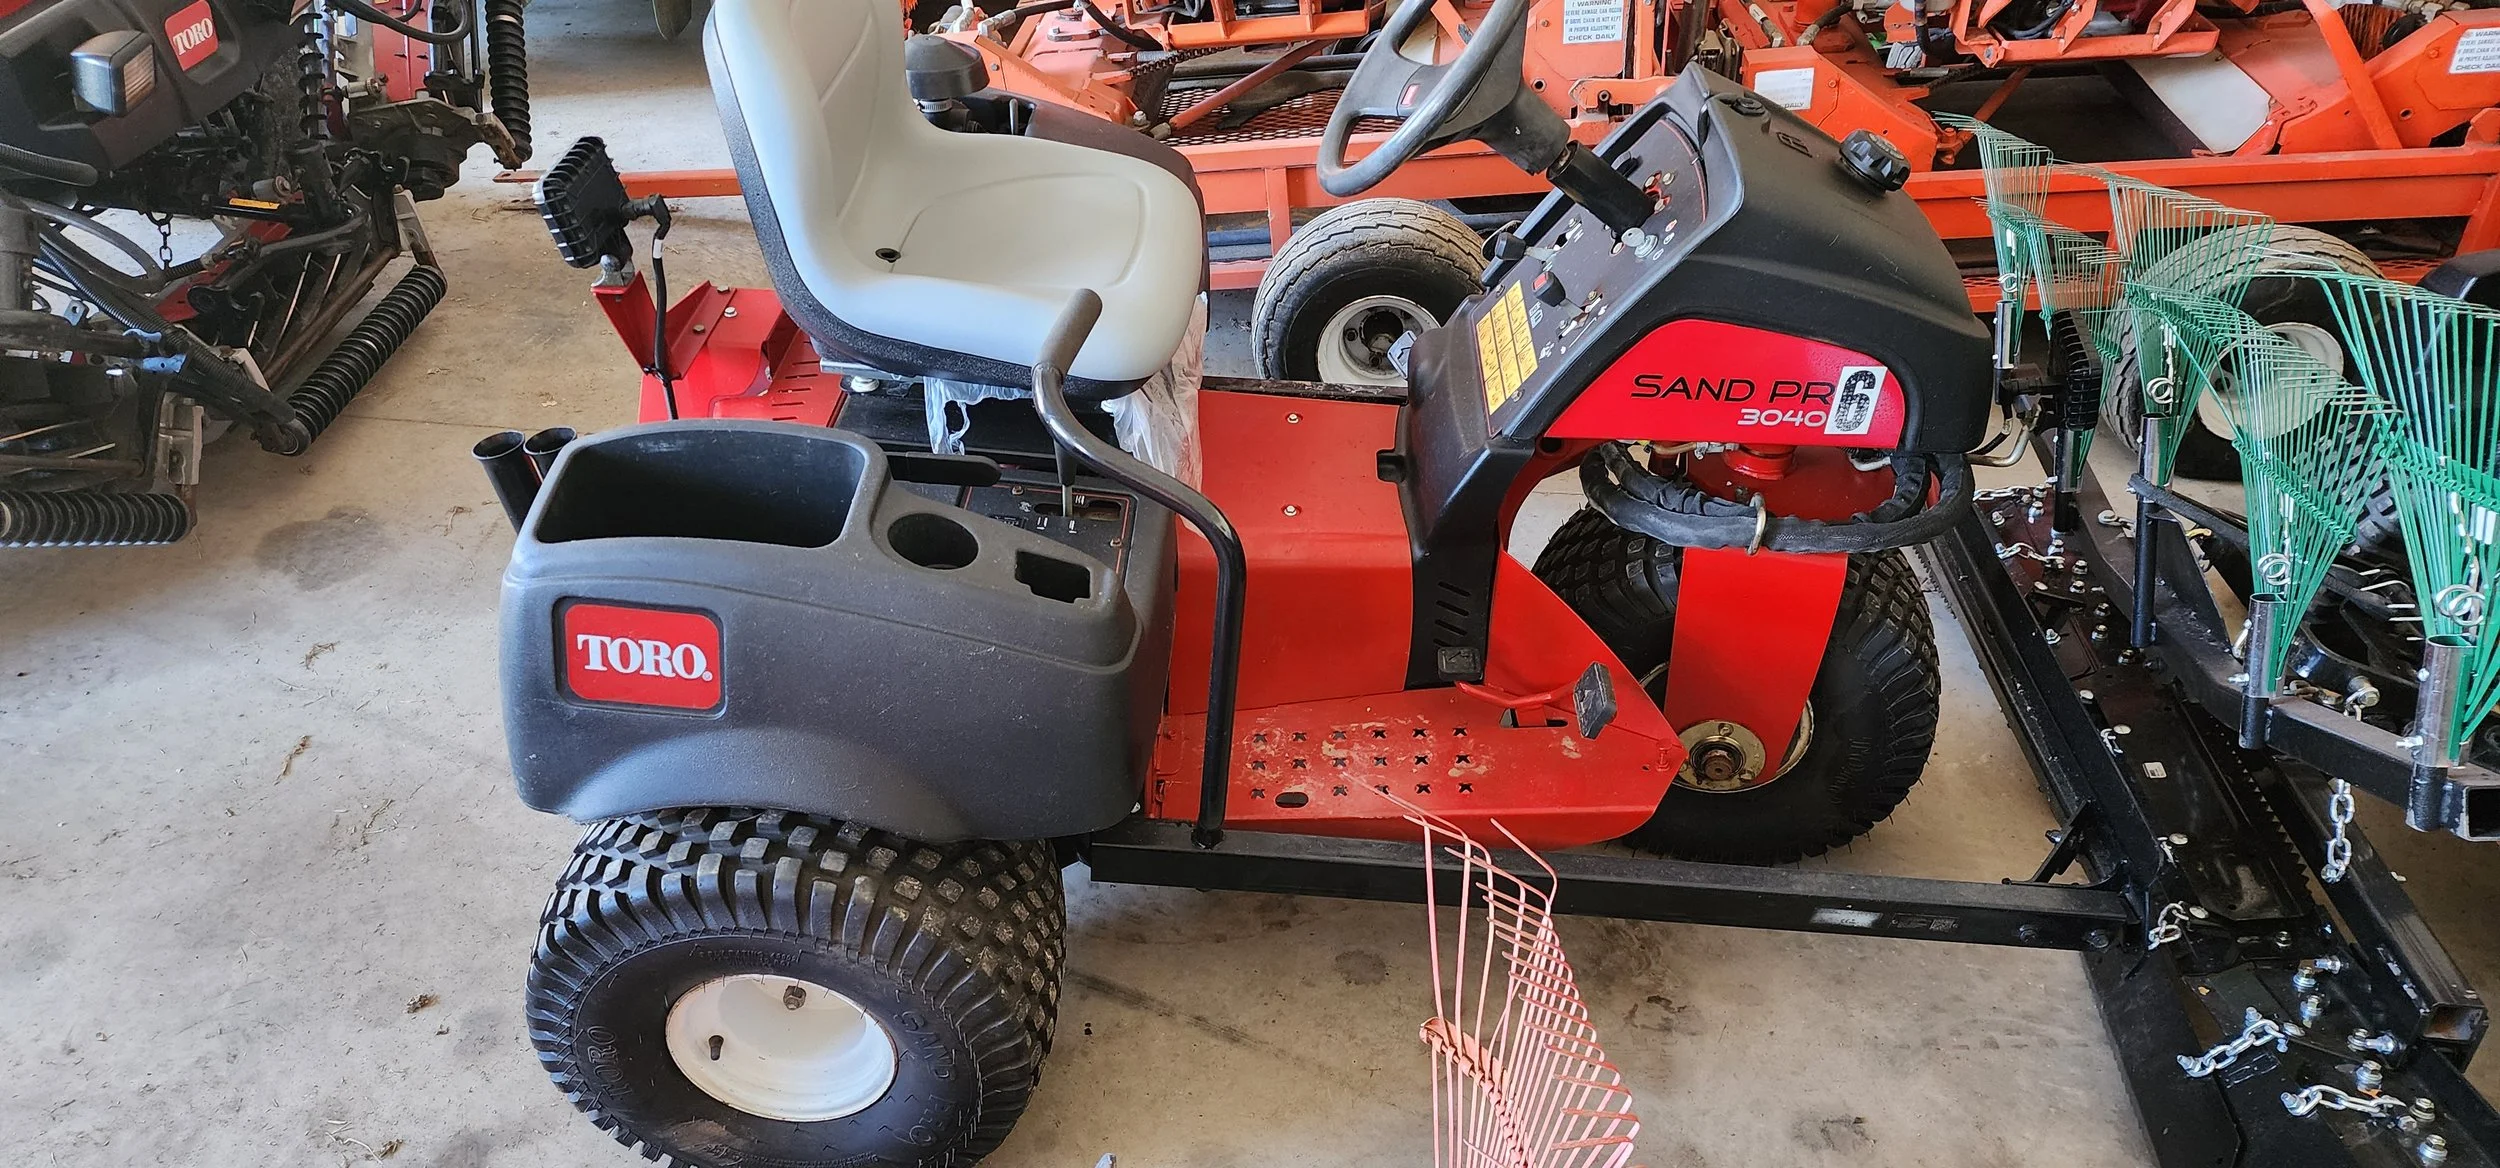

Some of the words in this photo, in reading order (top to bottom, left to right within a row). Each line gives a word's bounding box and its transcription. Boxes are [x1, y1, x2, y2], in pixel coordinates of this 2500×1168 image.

[173, 18, 213, 56] TORO
[1631, 374, 1755, 402] SAND
[1768, 380, 1835, 405] PR
[1834, 370, 1876, 432] 6
[1737, 408, 1827, 427] 3040
[586, 1025, 633, 1098] TORO
